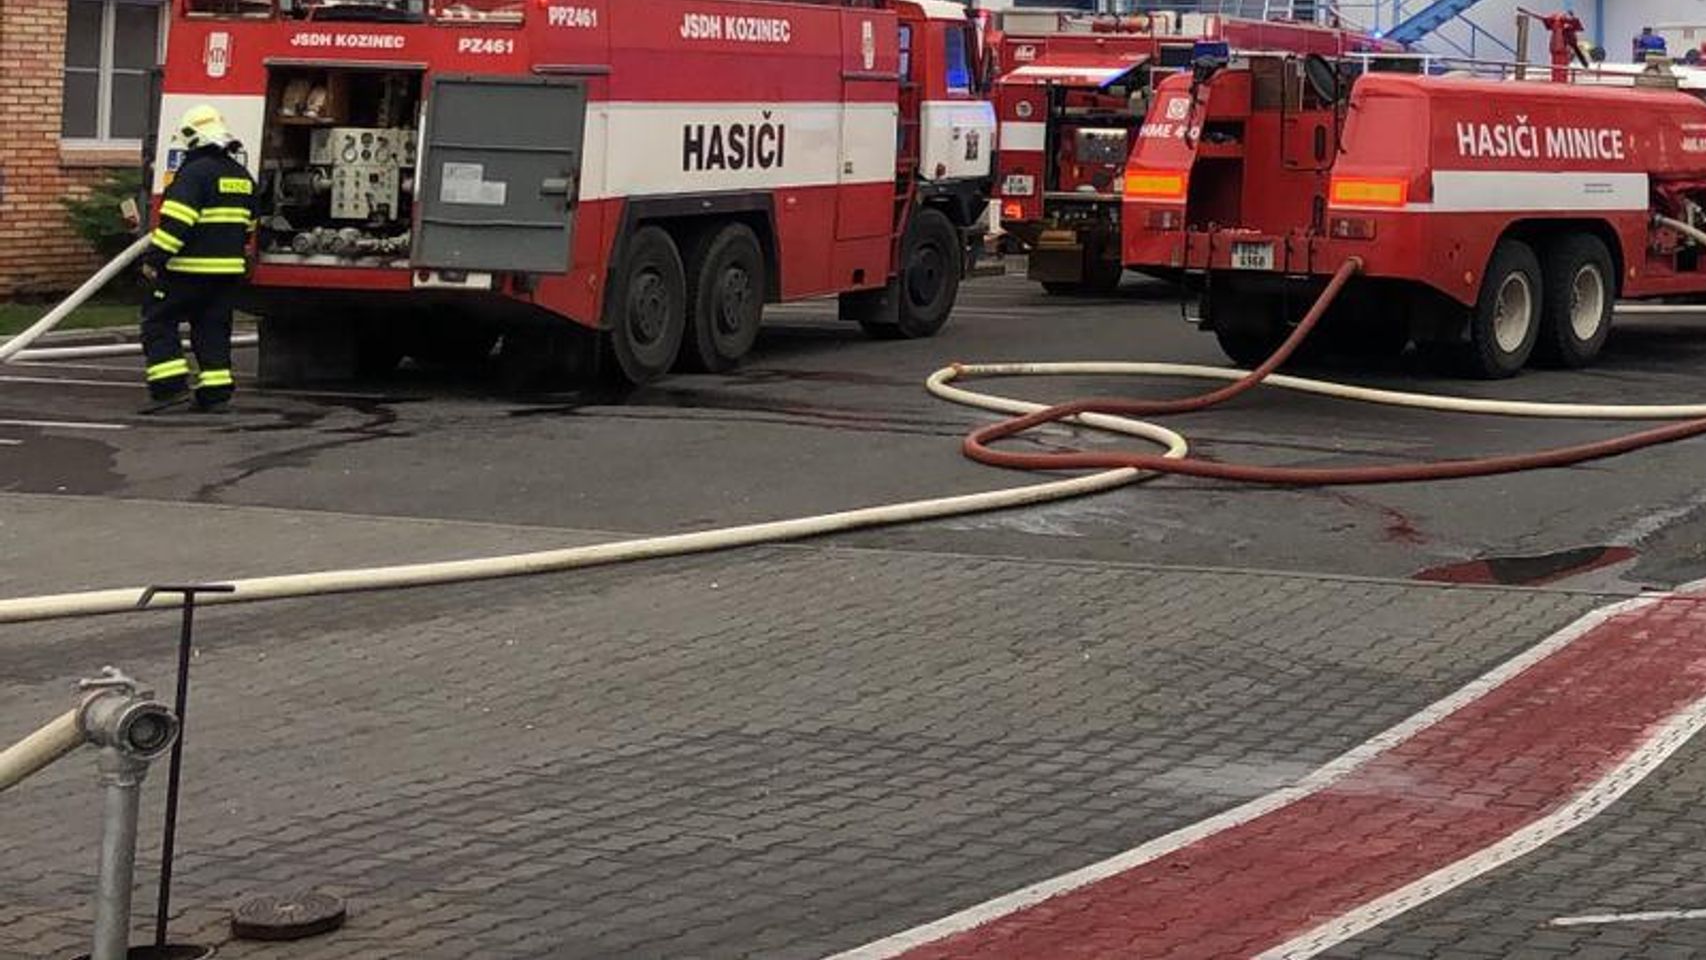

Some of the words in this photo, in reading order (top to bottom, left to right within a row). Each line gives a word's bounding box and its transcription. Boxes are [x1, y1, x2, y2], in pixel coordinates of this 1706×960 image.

[548, 6, 598, 28] PPZ461
[680, 13, 722, 39] JSDH
[725, 16, 791, 43] KOZINEC
[290, 33, 332, 46] JSDH
[335, 34, 405, 48] KOZINEC
[458, 38, 514, 54] PZ461
[682, 110, 785, 172] HASIČI
[1456, 114, 1540, 159] HASIČI
[1546, 126, 1625, 159] MINICE
